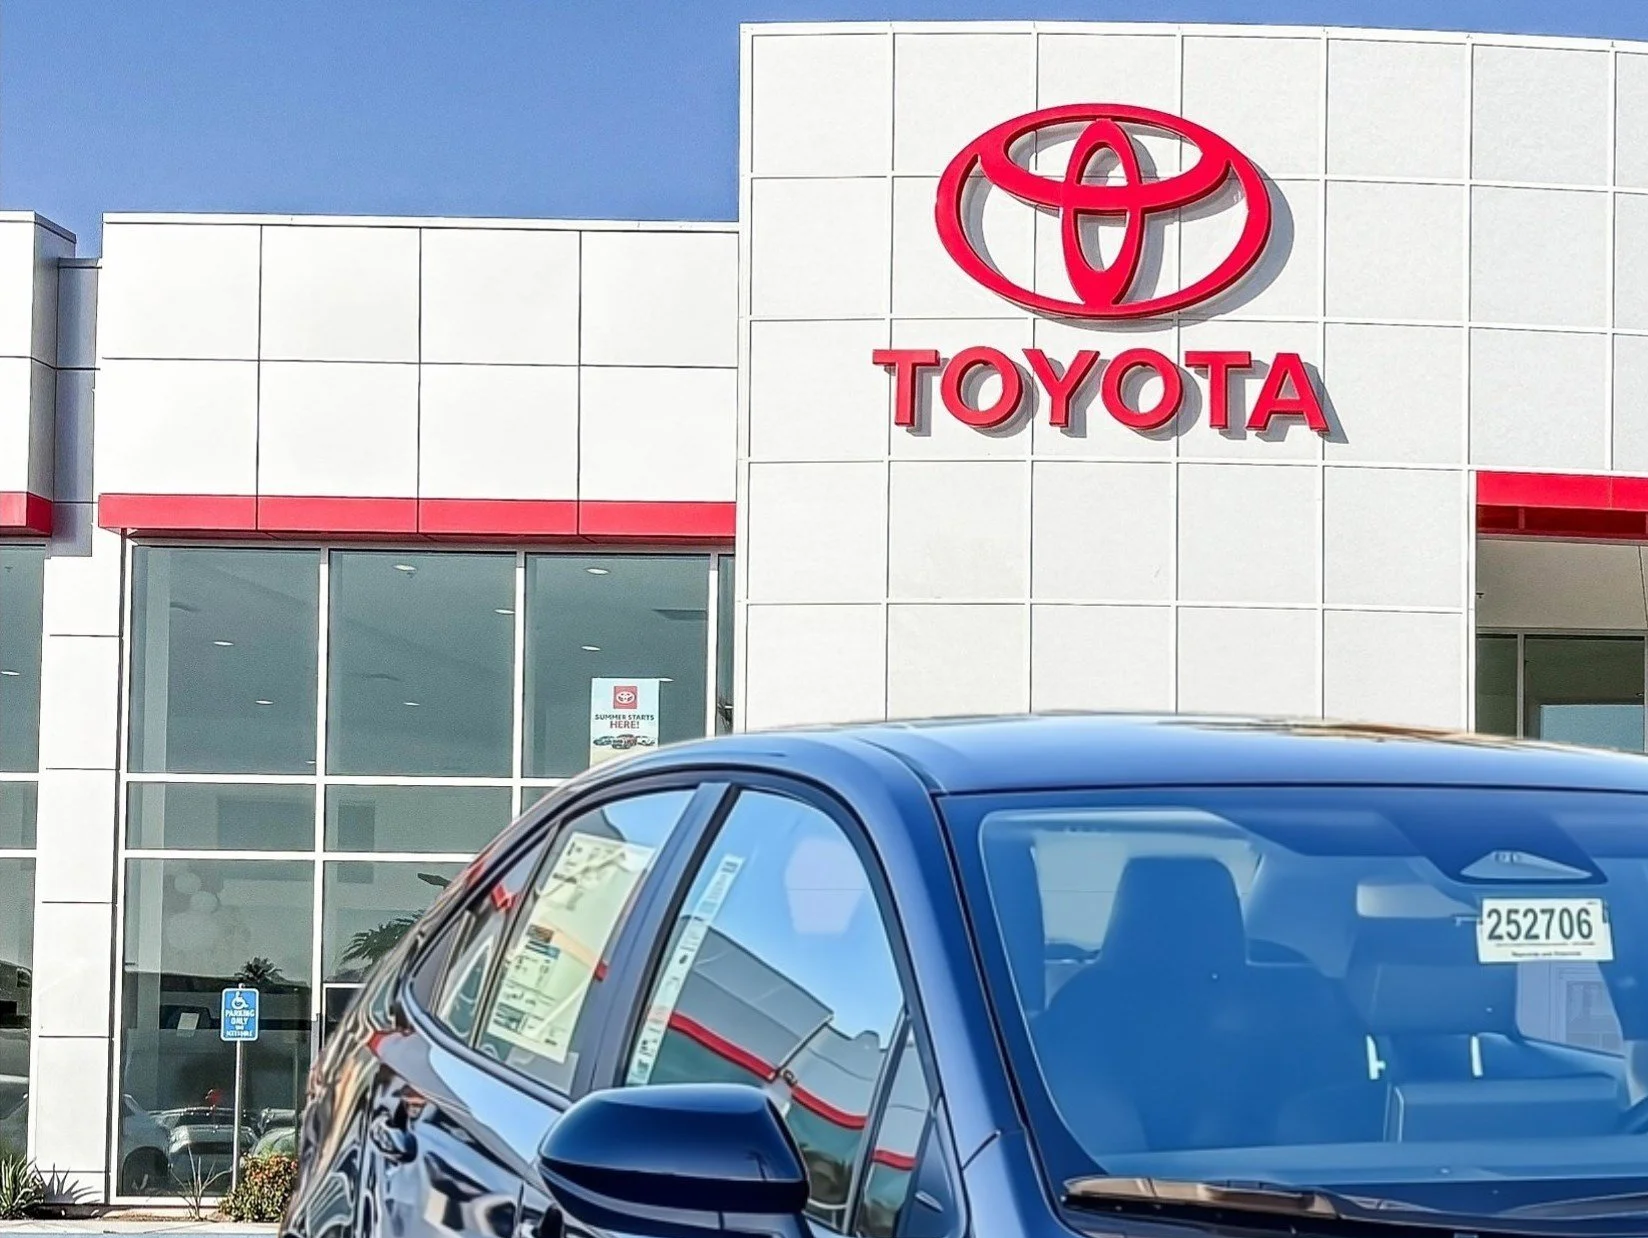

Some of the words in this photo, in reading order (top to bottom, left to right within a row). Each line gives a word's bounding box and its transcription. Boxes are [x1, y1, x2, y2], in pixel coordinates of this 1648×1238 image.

[872, 346, 1330, 434] TOYOTA
[610, 720, 640, 729] HERE!
[1486, 907, 1594, 941] 252706
[225, 1009, 255, 1017] PARKING
[230, 1017, 249, 1025] ONLY
